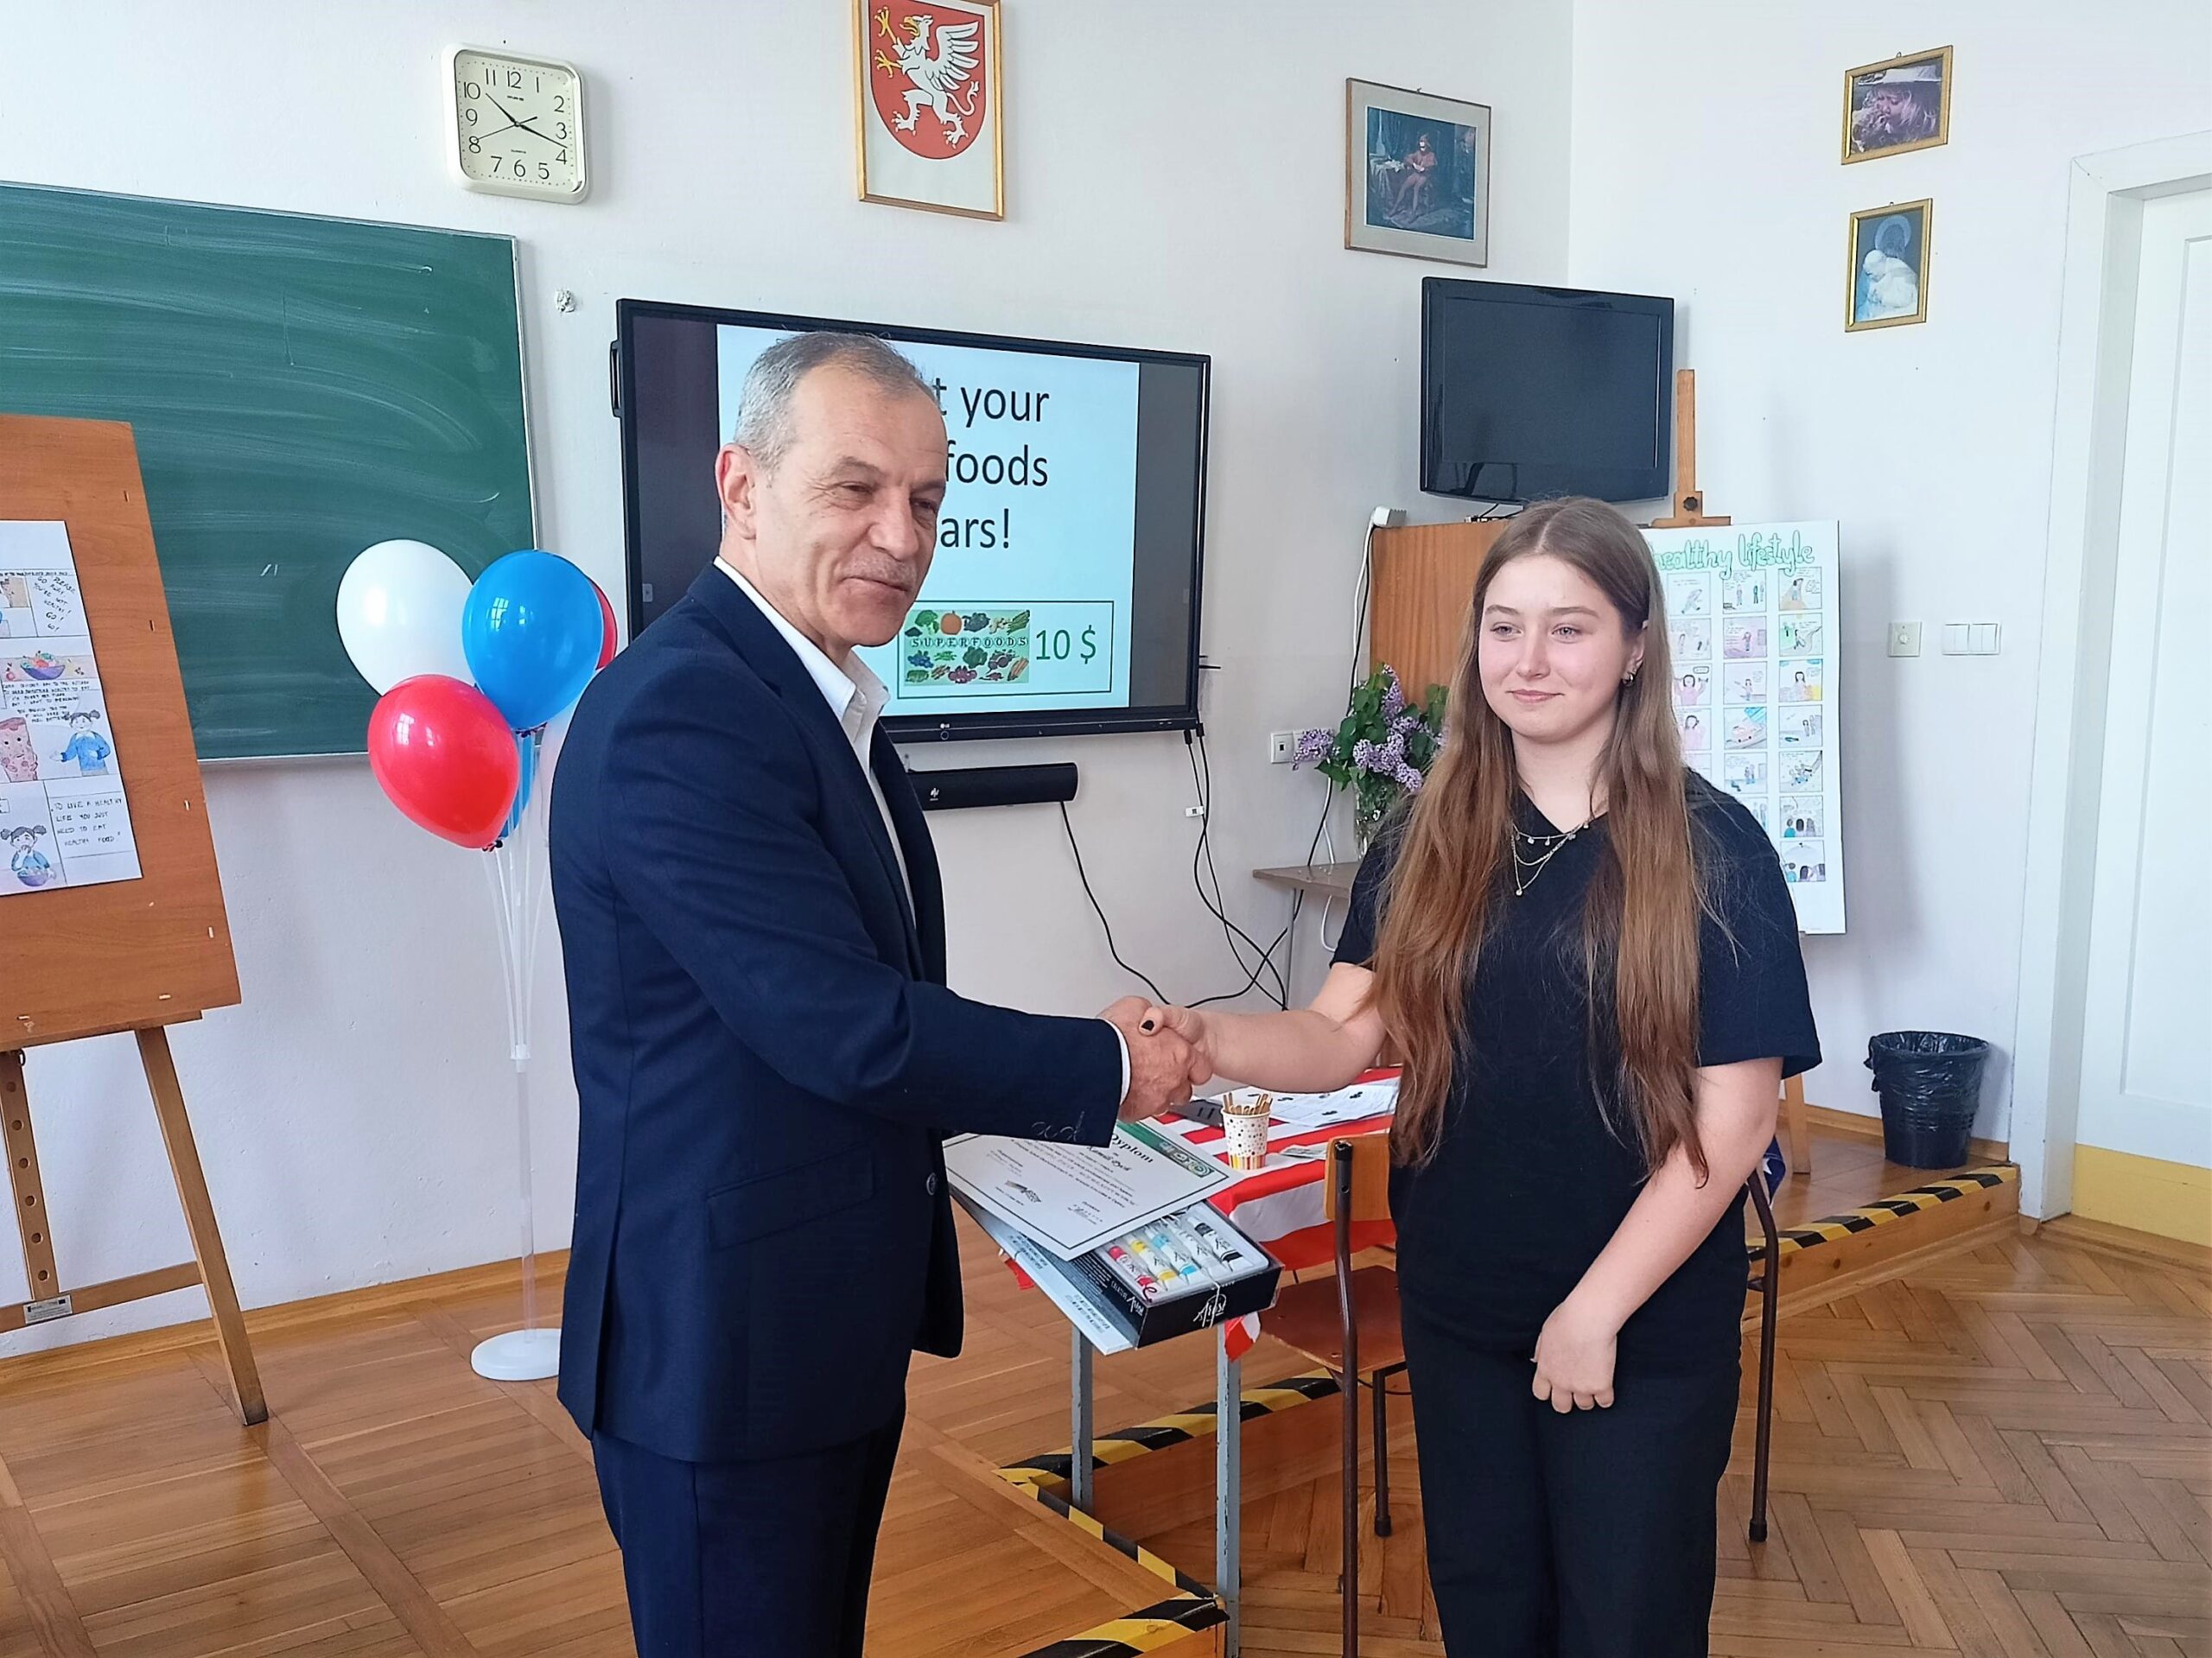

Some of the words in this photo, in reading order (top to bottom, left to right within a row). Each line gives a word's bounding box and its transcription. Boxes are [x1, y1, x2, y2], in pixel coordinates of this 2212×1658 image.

[486, 68, 496, 86] 11
[507, 70, 522, 89] 12
[536, 76, 540, 93] 1
[464, 81, 481, 99] 10
[554, 95, 564, 113] 2
[465, 108, 478, 126] 9
[556, 122, 568, 140] 3
[468, 136, 481, 154] 8
[491, 156, 503, 173] 7
[556, 149, 568, 165] 4
[514, 159, 526, 177] 6
[538, 162, 550, 180] 5
[961, 386, 1050, 428] your
[940, 508, 1010, 549] ars!
[1738, 530, 1815, 577] lifestyle
[912, 636, 1028, 647] SUPERFOODS
[1036, 629, 1071, 661] 10
[1080, 624, 1096, 664] $
